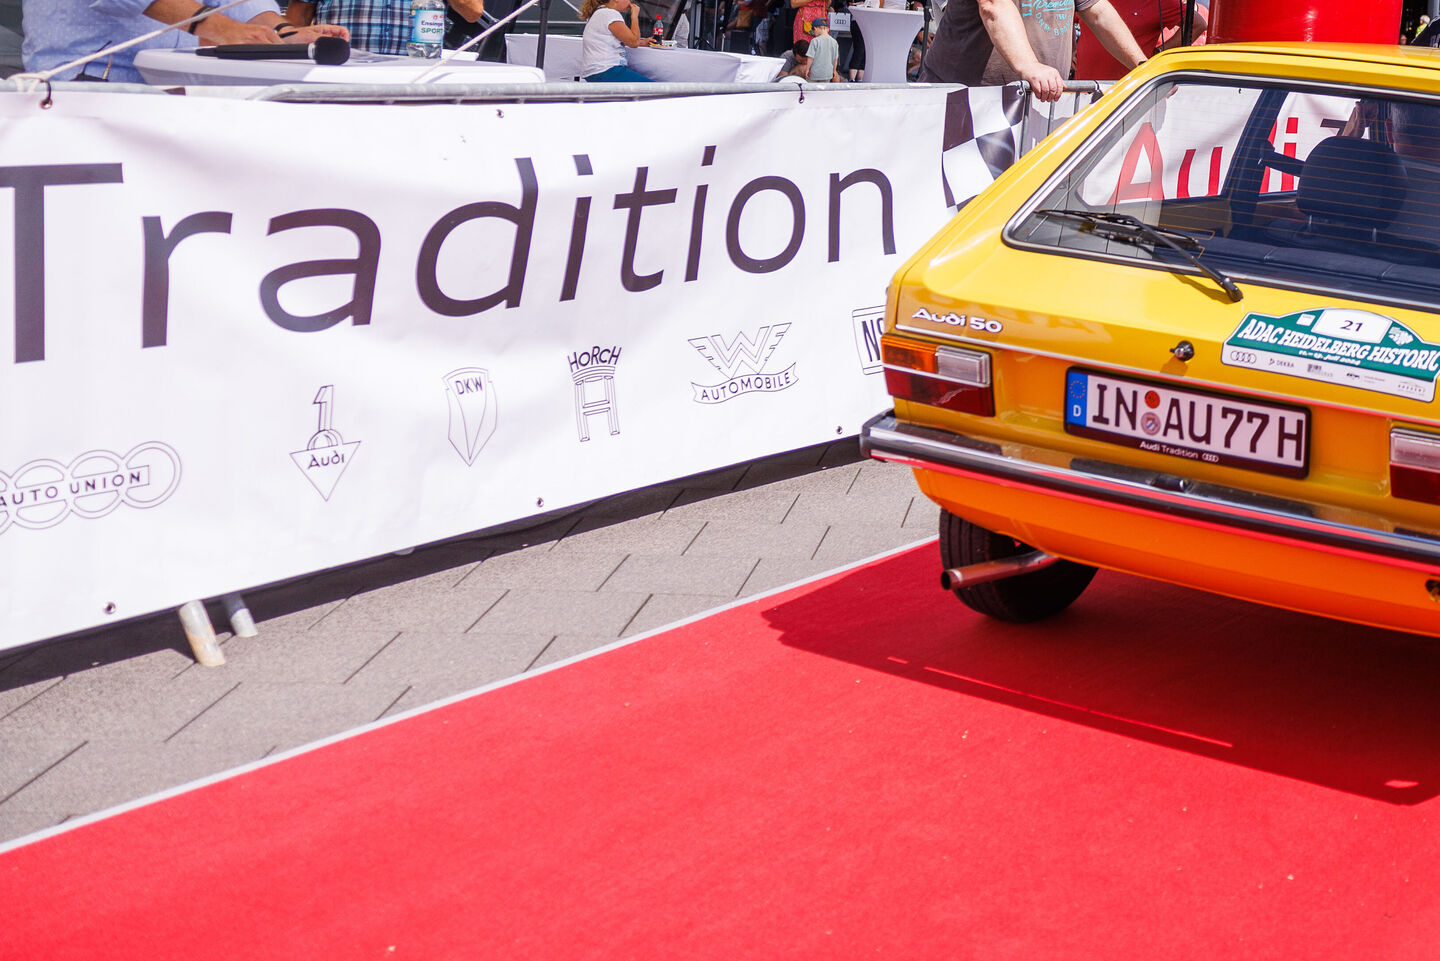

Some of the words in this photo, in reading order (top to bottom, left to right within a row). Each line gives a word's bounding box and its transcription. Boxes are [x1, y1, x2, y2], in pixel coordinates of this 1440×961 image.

[0, 145, 897, 365] Tradition
[912, 307, 967, 327] Audi
[969, 315, 1004, 334] 50
[1339, 319, 1364, 333] 21
[1237, 317, 1282, 345] ADAC
[1276, 330, 1371, 361] HEIDELBERG
[567, 345, 622, 373] HORCH
[454, 376, 484, 395] DKW
[700, 372, 792, 401] AUTOMOBILE
[1072, 404, 1082, 418] D
[1092, 383, 1139, 431] IN
[307, 449, 346, 471] Audi
[1140, 440, 1161, 452] Audi
[1162, 444, 1199, 460] Tradition
[0, 485, 59, 508] AUTO
[69, 471, 141, 494] UNION
